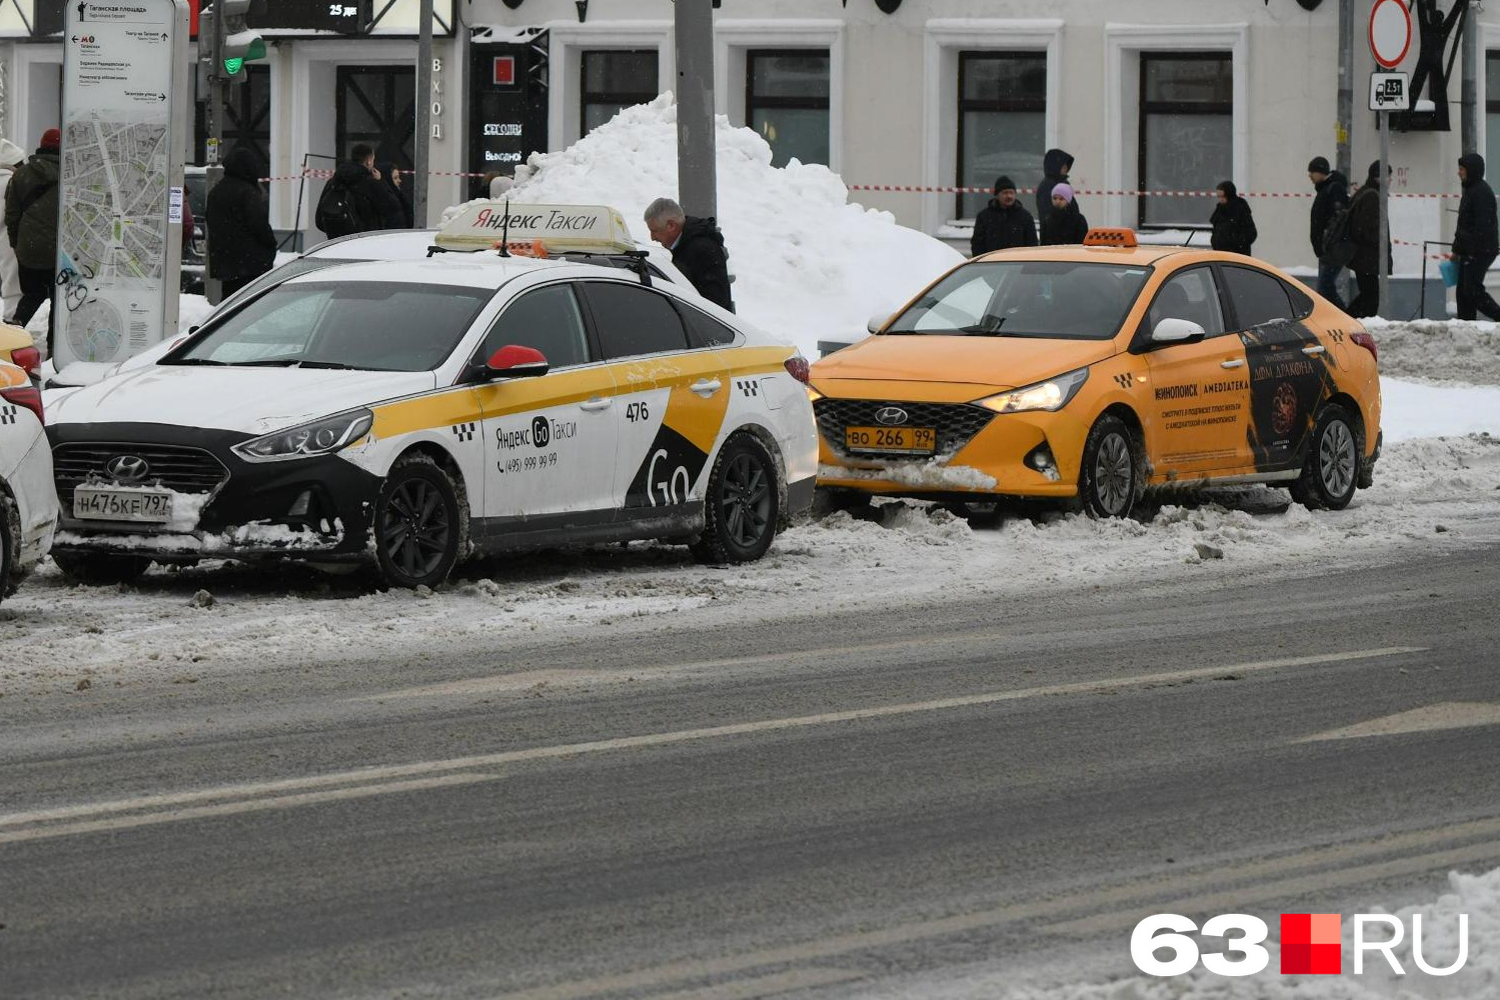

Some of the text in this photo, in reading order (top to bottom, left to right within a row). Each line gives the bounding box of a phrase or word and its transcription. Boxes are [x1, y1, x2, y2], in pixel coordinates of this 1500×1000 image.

[329, 4, 343, 16] 25
[432, 58, 441, 139] ВХОД
[472, 208, 597, 230] Яндекс Такси
[626, 401, 649, 423] 476
[496, 418, 577, 451] Яндекс Go Такси
[876, 429, 904, 446] 266
[915, 430, 930, 442] 99
